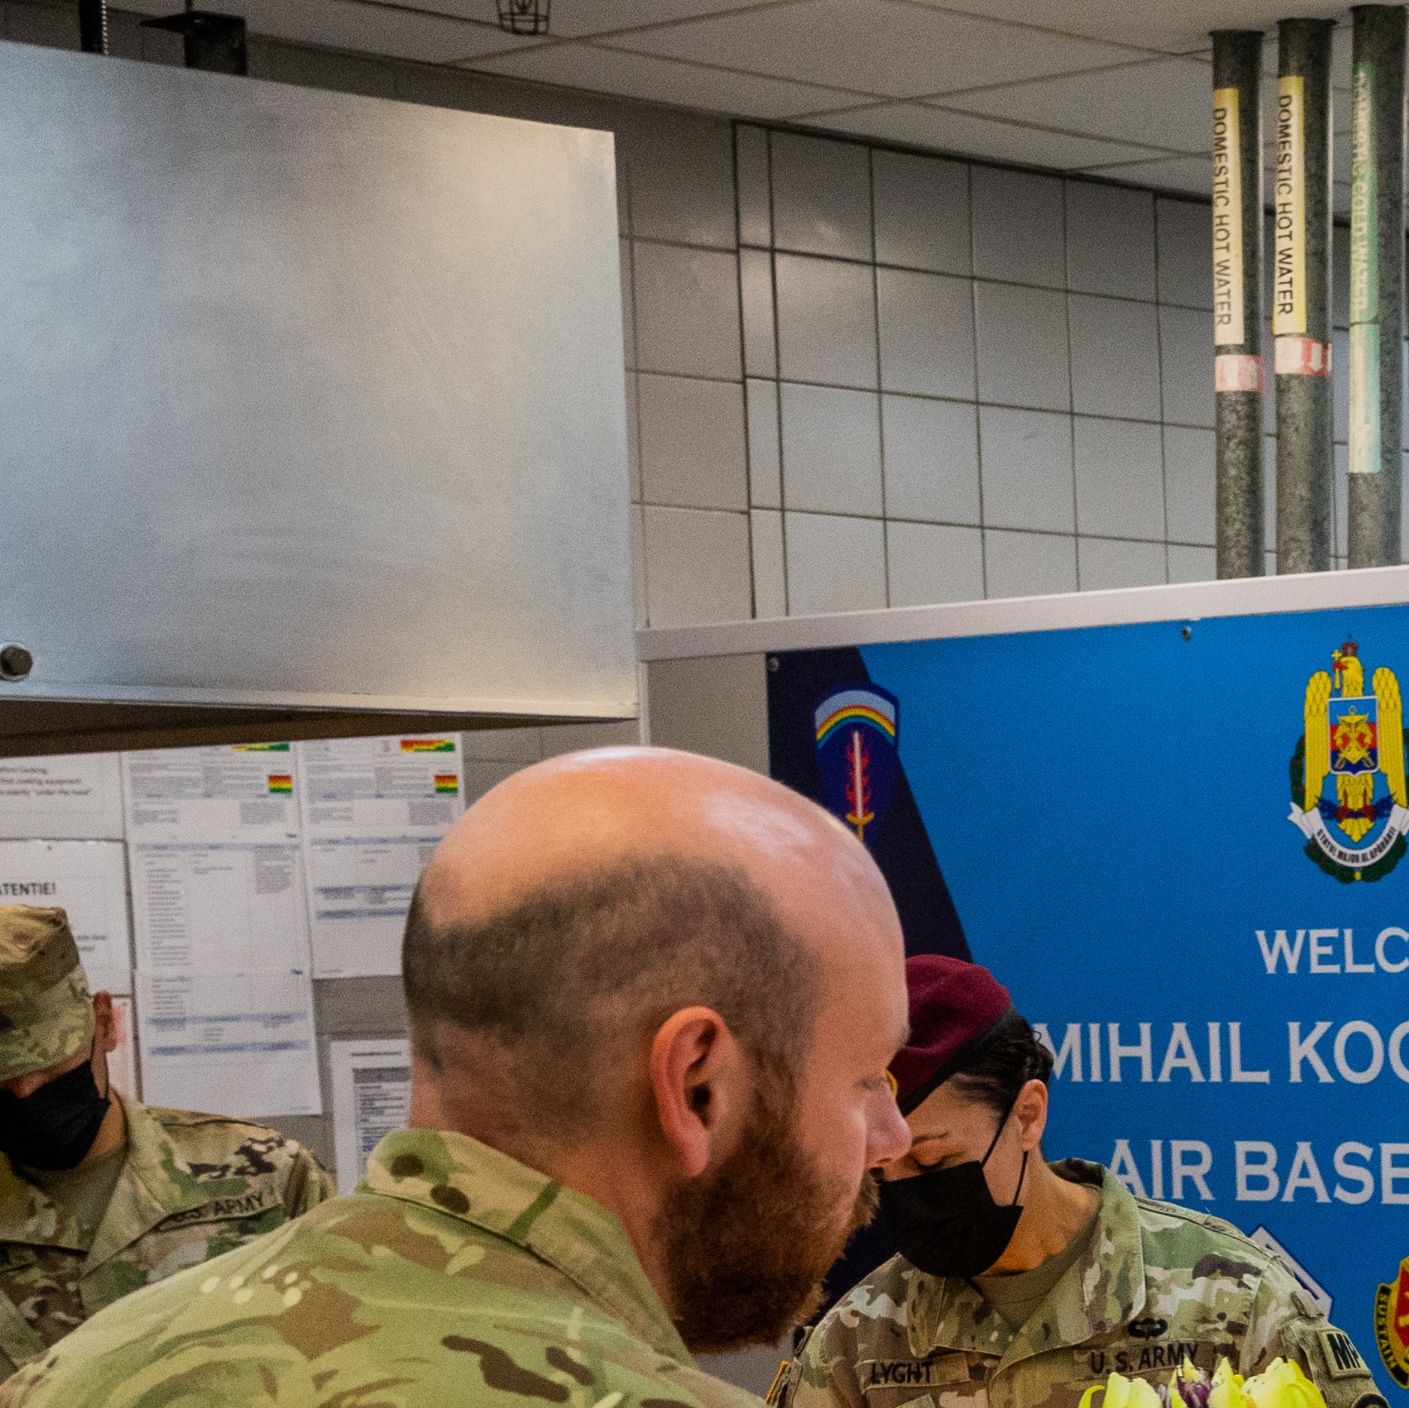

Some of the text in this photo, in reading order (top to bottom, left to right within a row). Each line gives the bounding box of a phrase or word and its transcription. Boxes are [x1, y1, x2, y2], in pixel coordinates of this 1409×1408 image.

[1214, 108, 1232, 325] DOMESTIC HOT WATER
[1277, 95, 1294, 314] DOMESTIC HOT WATER
[1035, 1021, 1270, 1084] MIHAIL
[1107, 1139, 1214, 1201] AIR
[213, 1190, 264, 1217] ARMY
[1090, 1343, 1200, 1374] U.S. ARMY
[1325, 1332, 1362, 1371] MP
[1377, 1293, 1398, 1369] SUSTAIN
[870, 1360, 934, 1385] LYGHT
